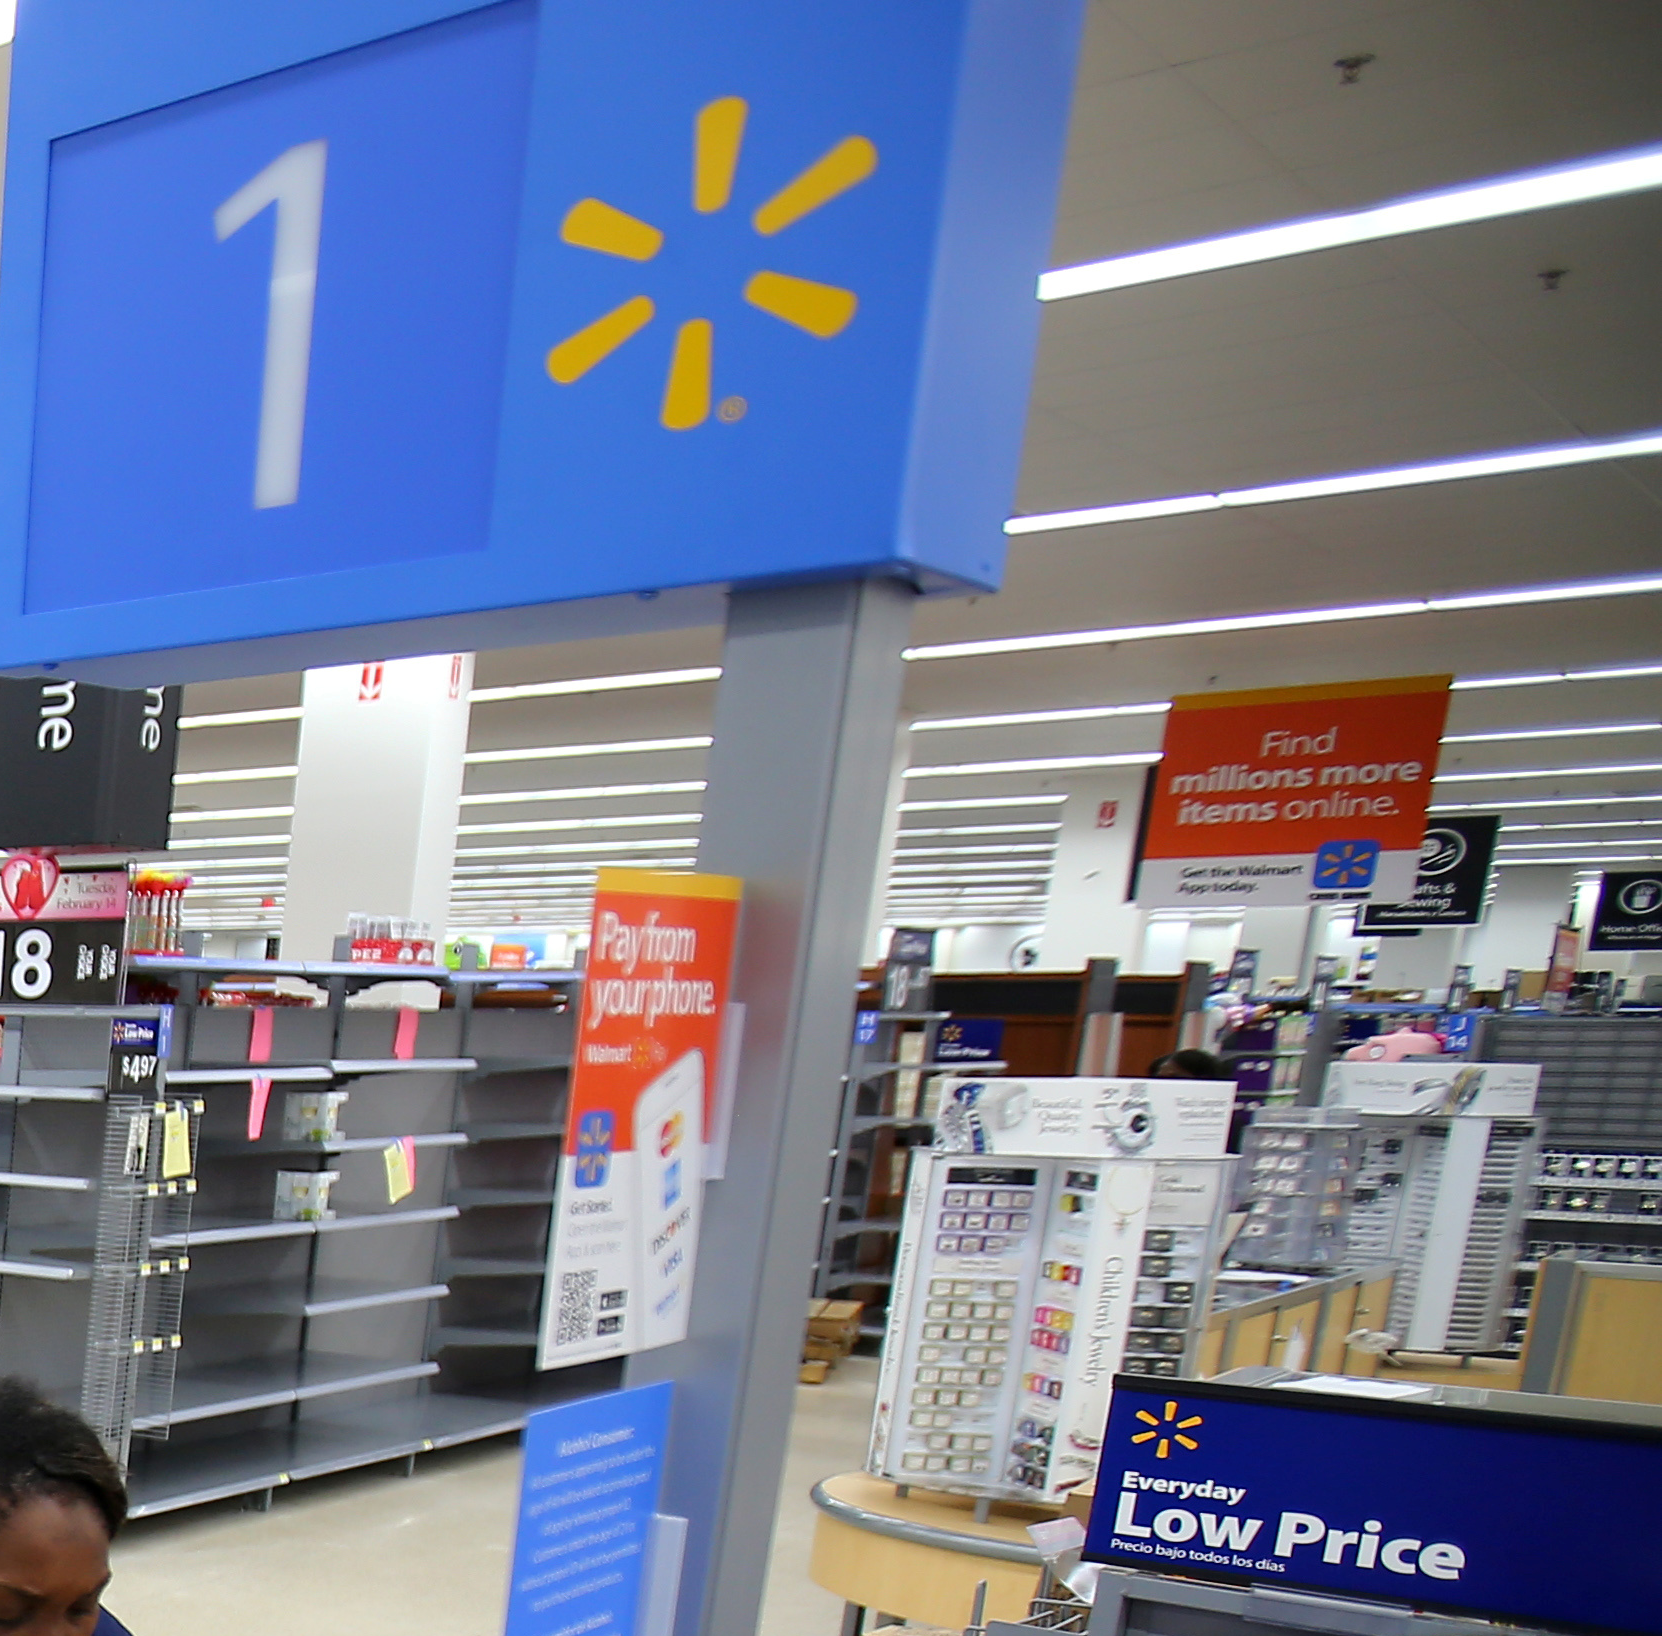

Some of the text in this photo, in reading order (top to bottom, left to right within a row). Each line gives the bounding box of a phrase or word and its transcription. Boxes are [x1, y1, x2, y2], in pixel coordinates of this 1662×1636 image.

[213, 140, 327, 511] 1
[1259, 727, 1337, 758] Find
[1169, 760, 1422, 795] millions more
[1177, 793, 1400, 826] items online.
[78, 881, 117, 896] Tuesday
[1177, 880, 1258, 895] App today.
[1181, 864, 1303, 880] Get the Walmart
[57, 899, 116, 910] February 14
[596, 911, 696, 975] Pay from
[589, 977, 716, 1031] your phone.
[1454, 1017, 1467, 1033] J
[585, 1043, 632, 1064] Walmart
[1447, 1035, 1467, 1049] 14
[1083, 1255, 1124, 1389] Children's Jewelry
[1122, 1470, 1246, 1506] Everyday
[1113, 1492, 1465, 1581] Low Price
[1111, 1538, 1285, 1573] Precio bajo todos los días
